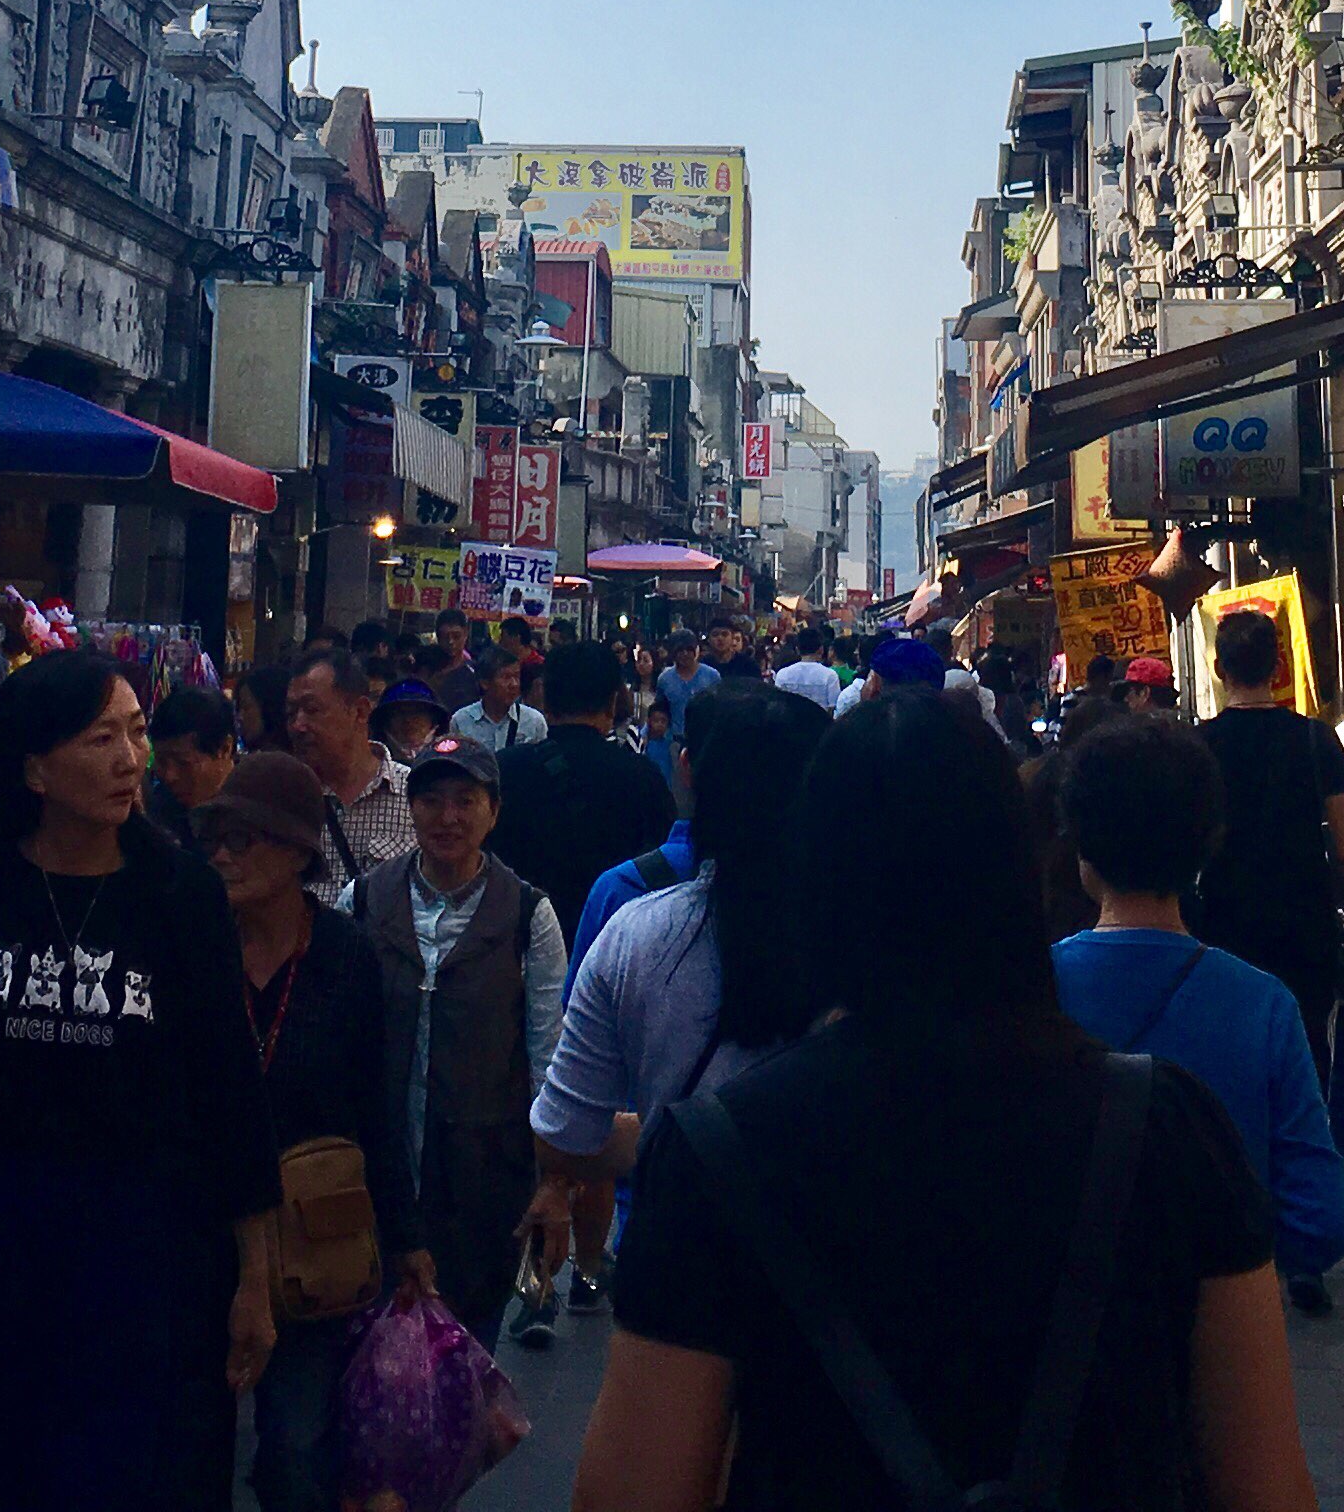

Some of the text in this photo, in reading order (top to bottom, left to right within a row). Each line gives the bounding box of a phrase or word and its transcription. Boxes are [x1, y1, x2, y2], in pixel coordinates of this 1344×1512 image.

[524, 159, 708, 190] 大溪拿破崙派
[356, 367, 389, 386] 大溪
[1193, 416, 1268, 453] QQ
[748, 425, 765, 476] 月光餅
[1179, 456, 1286, 486] MONKEY
[477, 553, 553, 585] 蝶豆花
[6, 1016, 114, 1047] NICE DOGS
